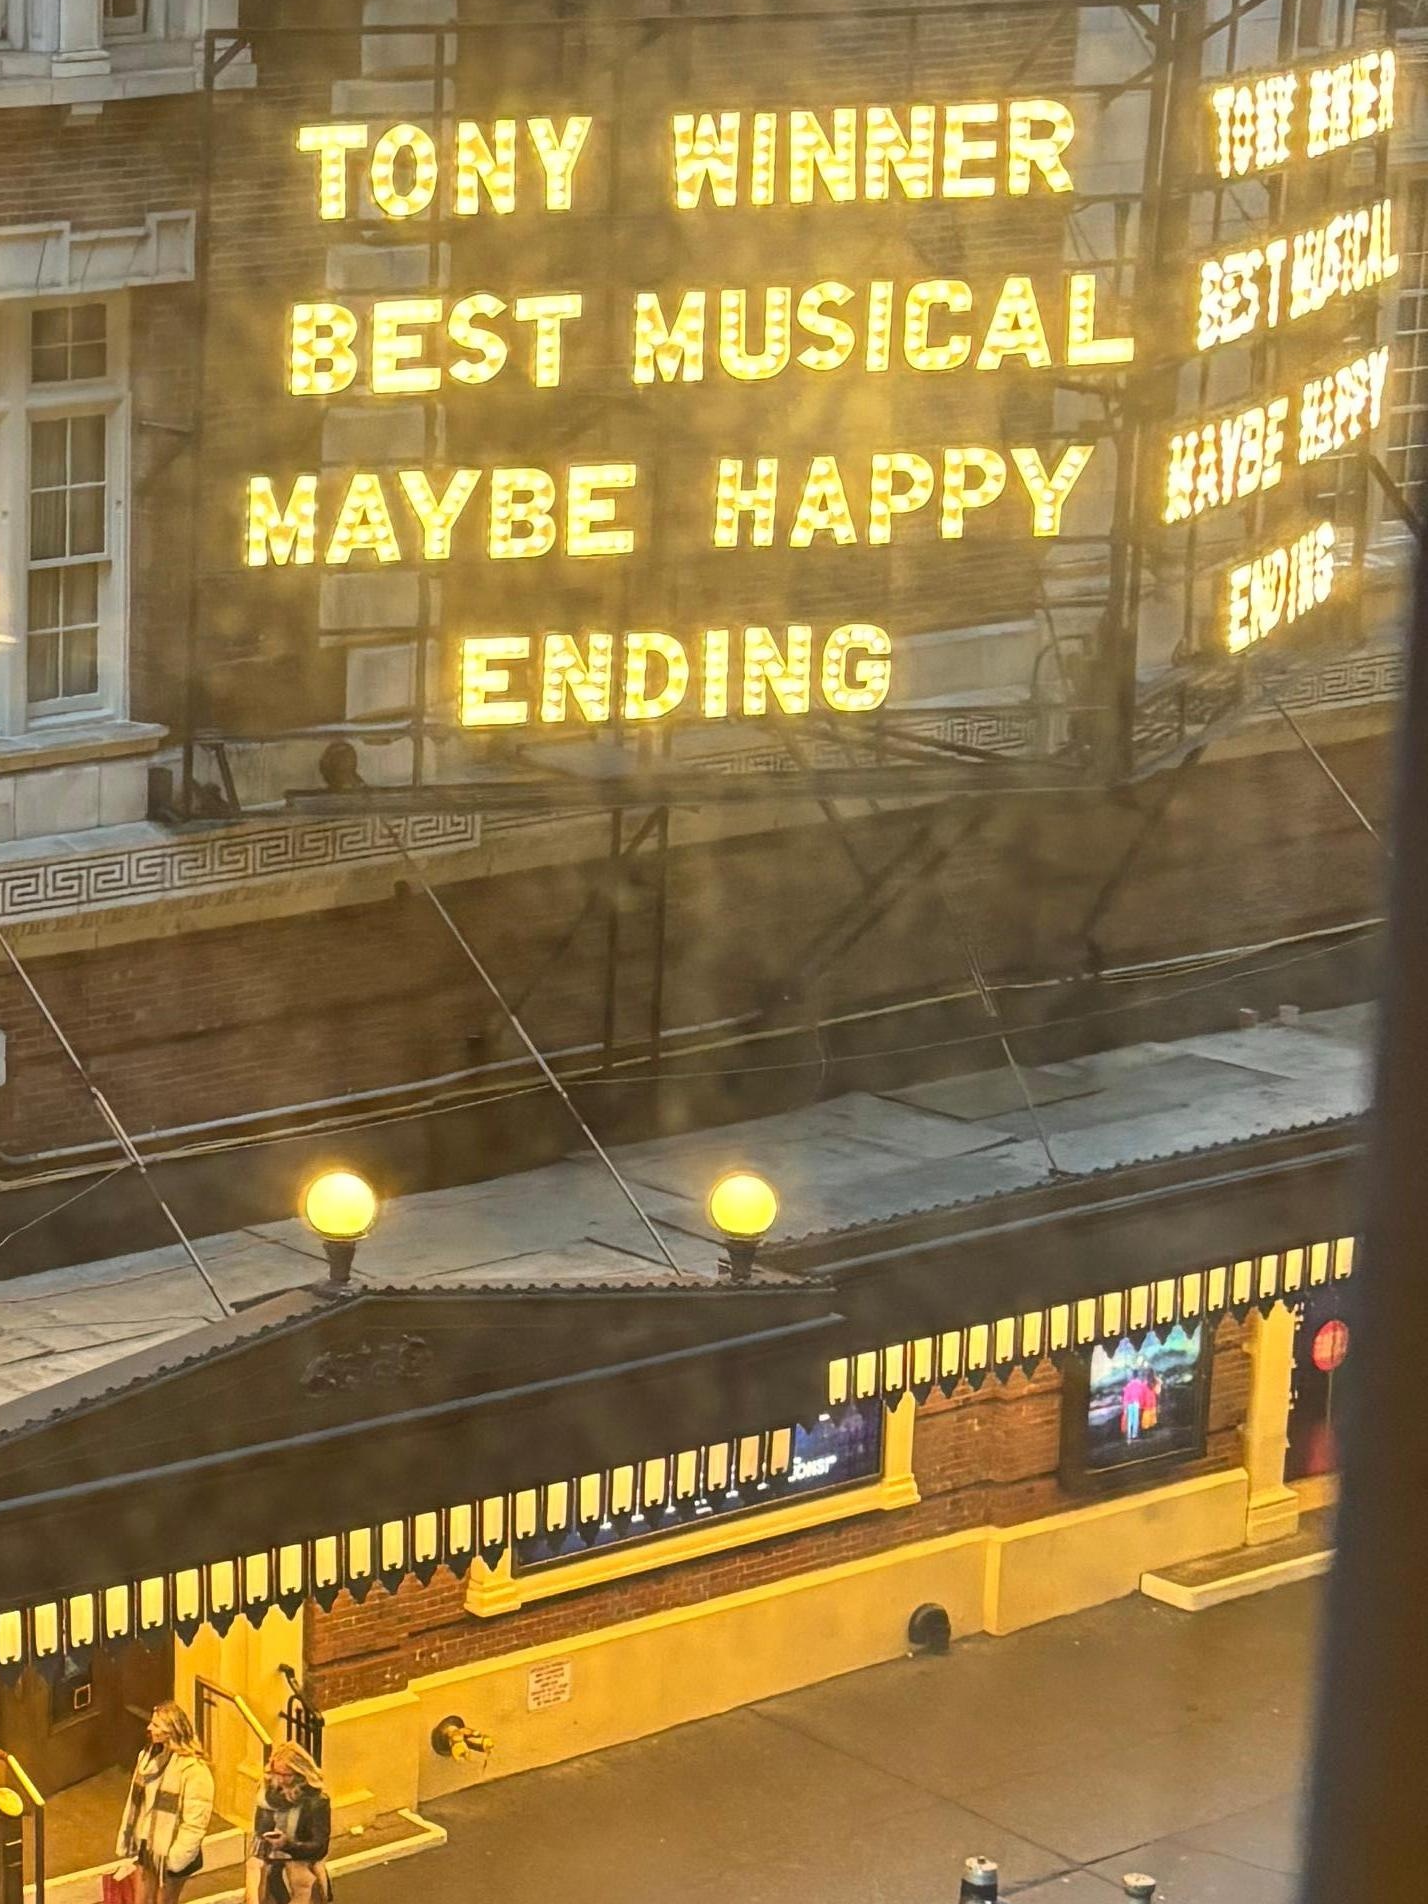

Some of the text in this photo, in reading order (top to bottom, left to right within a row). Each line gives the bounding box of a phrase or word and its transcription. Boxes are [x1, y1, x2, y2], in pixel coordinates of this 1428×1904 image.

[297, 99, 1077, 221] TONY WINNER
[1212, 72, 1297, 179] TONY
[289, 274, 1135, 396] BEST MUSICAL
[1197, 199, 1400, 350] BEST MUSICAL
[1164, 345, 1389, 523] MAYBE HAPPY
[246, 445, 1094, 568] MAYBE HAPPY
[1226, 521, 1335, 655] ENDING
[459, 624, 893, 727] ENDING
